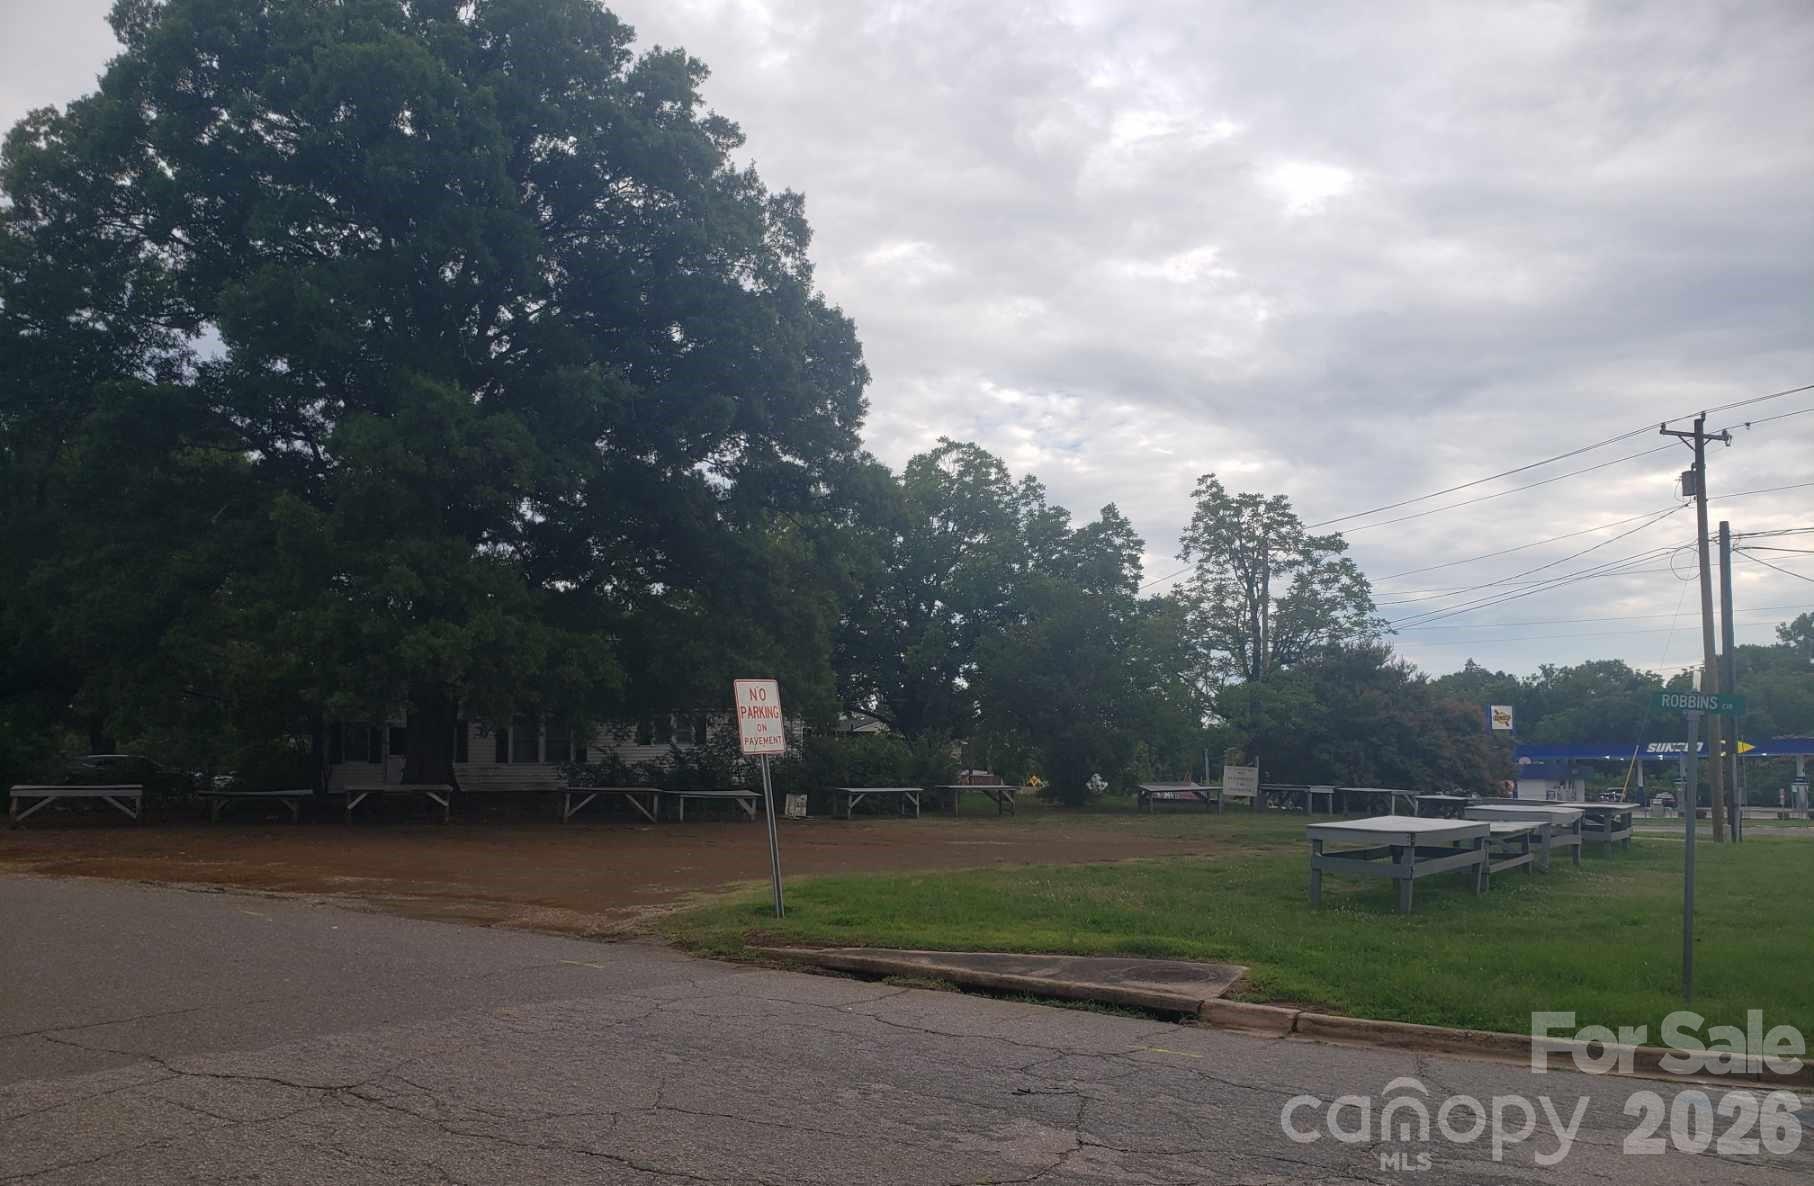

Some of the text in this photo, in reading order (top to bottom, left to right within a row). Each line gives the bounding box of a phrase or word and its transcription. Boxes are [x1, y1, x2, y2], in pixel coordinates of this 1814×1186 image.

[749, 688, 767, 701] NO
[1661, 694, 1719, 710] ROBBINS
[740, 705, 779, 719] PARKING
[756, 723, 768, 732] ON
[744, 736, 782, 745] PAVEMENT
